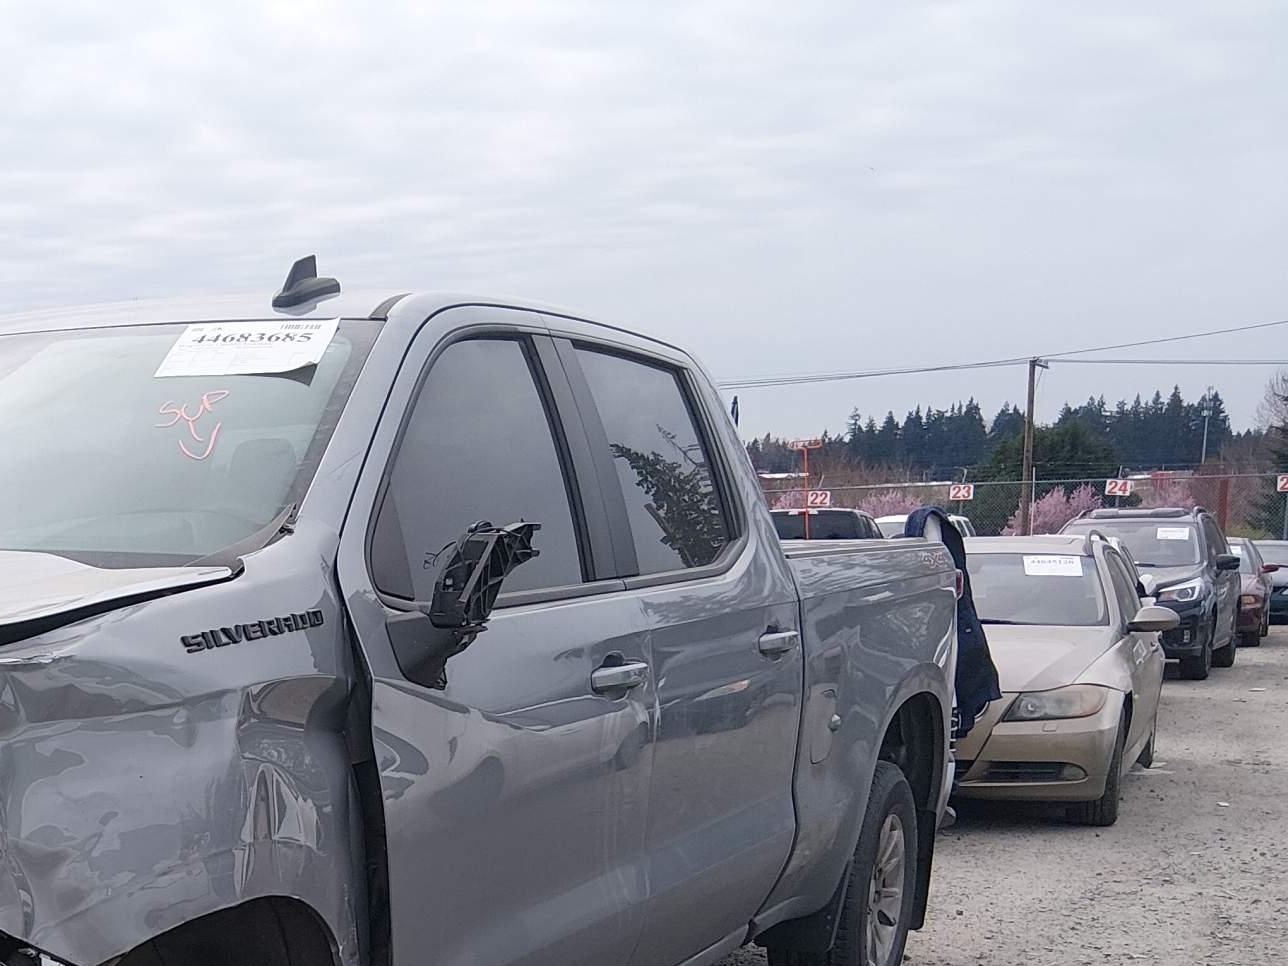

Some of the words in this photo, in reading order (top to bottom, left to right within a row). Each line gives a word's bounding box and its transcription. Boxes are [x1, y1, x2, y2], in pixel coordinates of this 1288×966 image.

[191, 332, 313, 345] 44683685
[1107, 480, 1129, 495] 24
[1279, 476, 1288, 491] 2
[809, 491, 829, 506] 22
[951, 485, 972, 499] 23
[179, 609, 324, 654] SILVERADO
